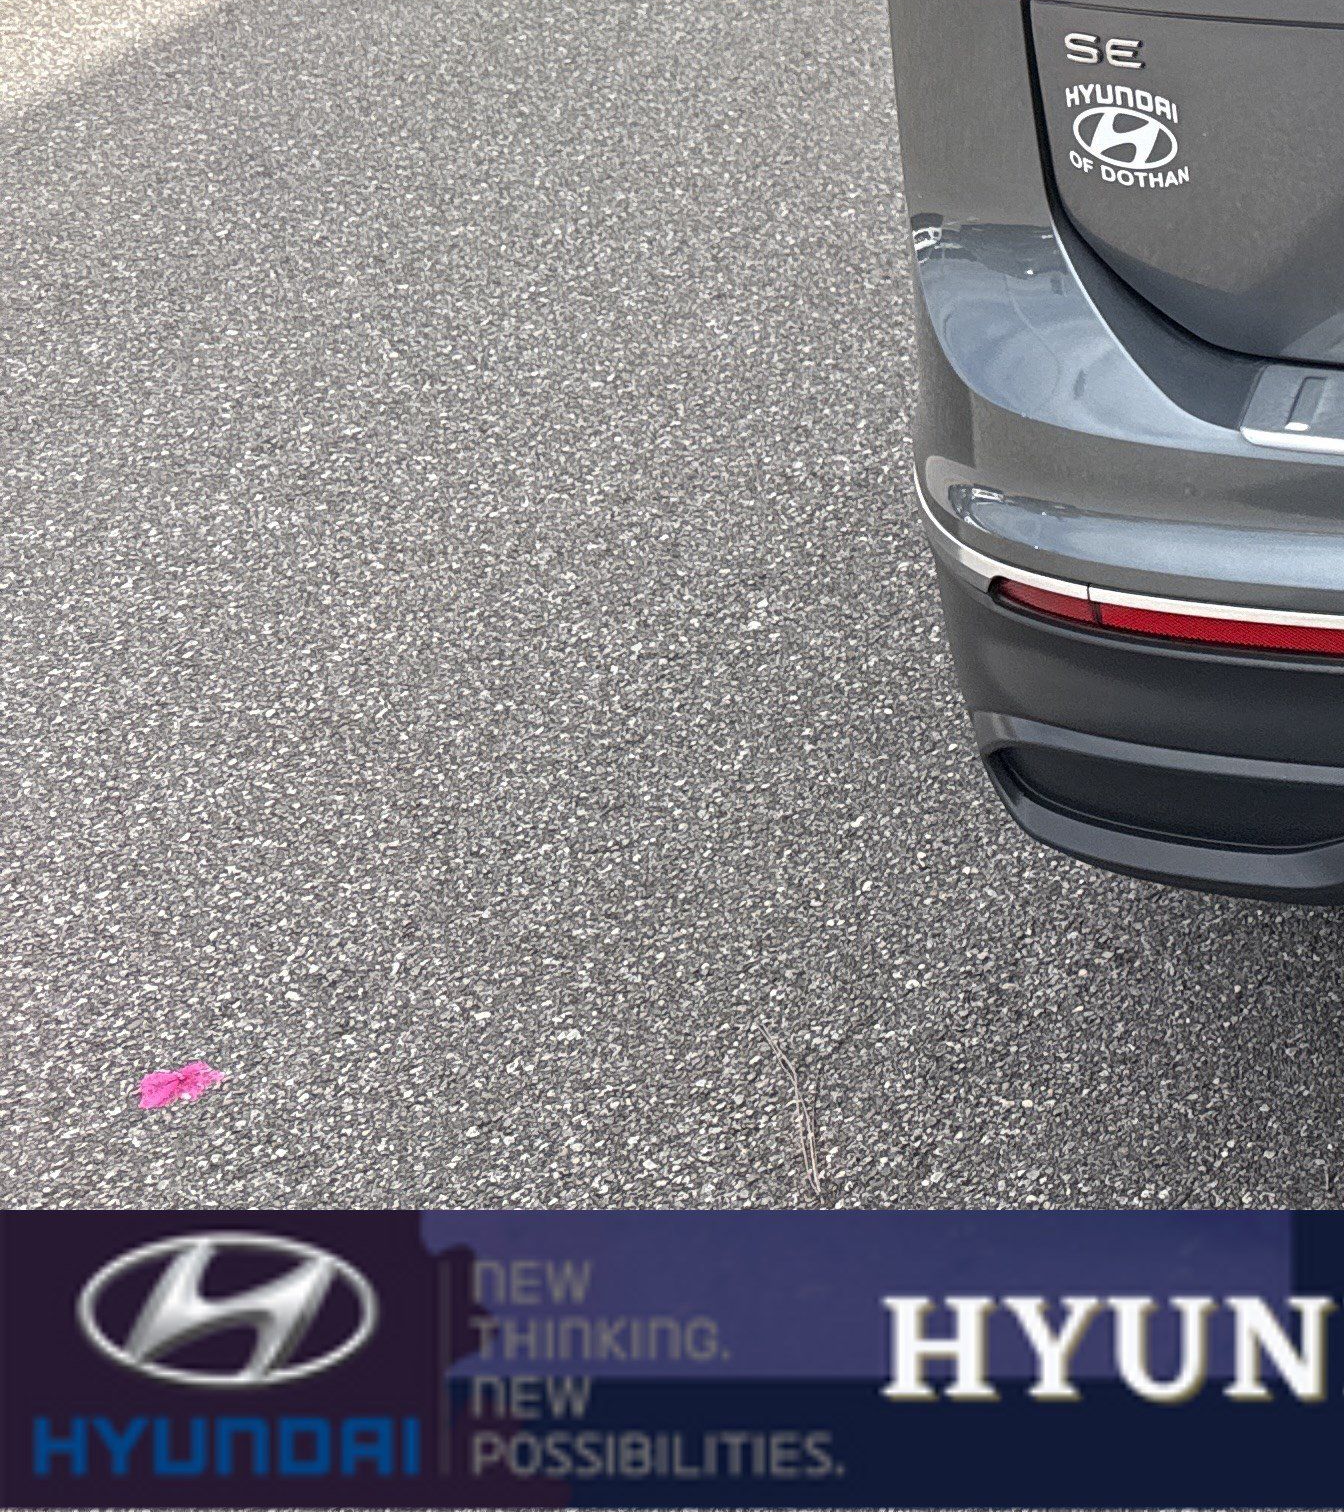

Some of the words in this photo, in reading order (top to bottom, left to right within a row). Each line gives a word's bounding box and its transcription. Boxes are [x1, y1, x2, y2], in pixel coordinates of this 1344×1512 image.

[1064, 32, 1146, 69] SE
[1065, 83, 1179, 124] HYUNDAI
[1069, 150, 1094, 173] OF
[1100, 165, 1190, 188] DOTHAN
